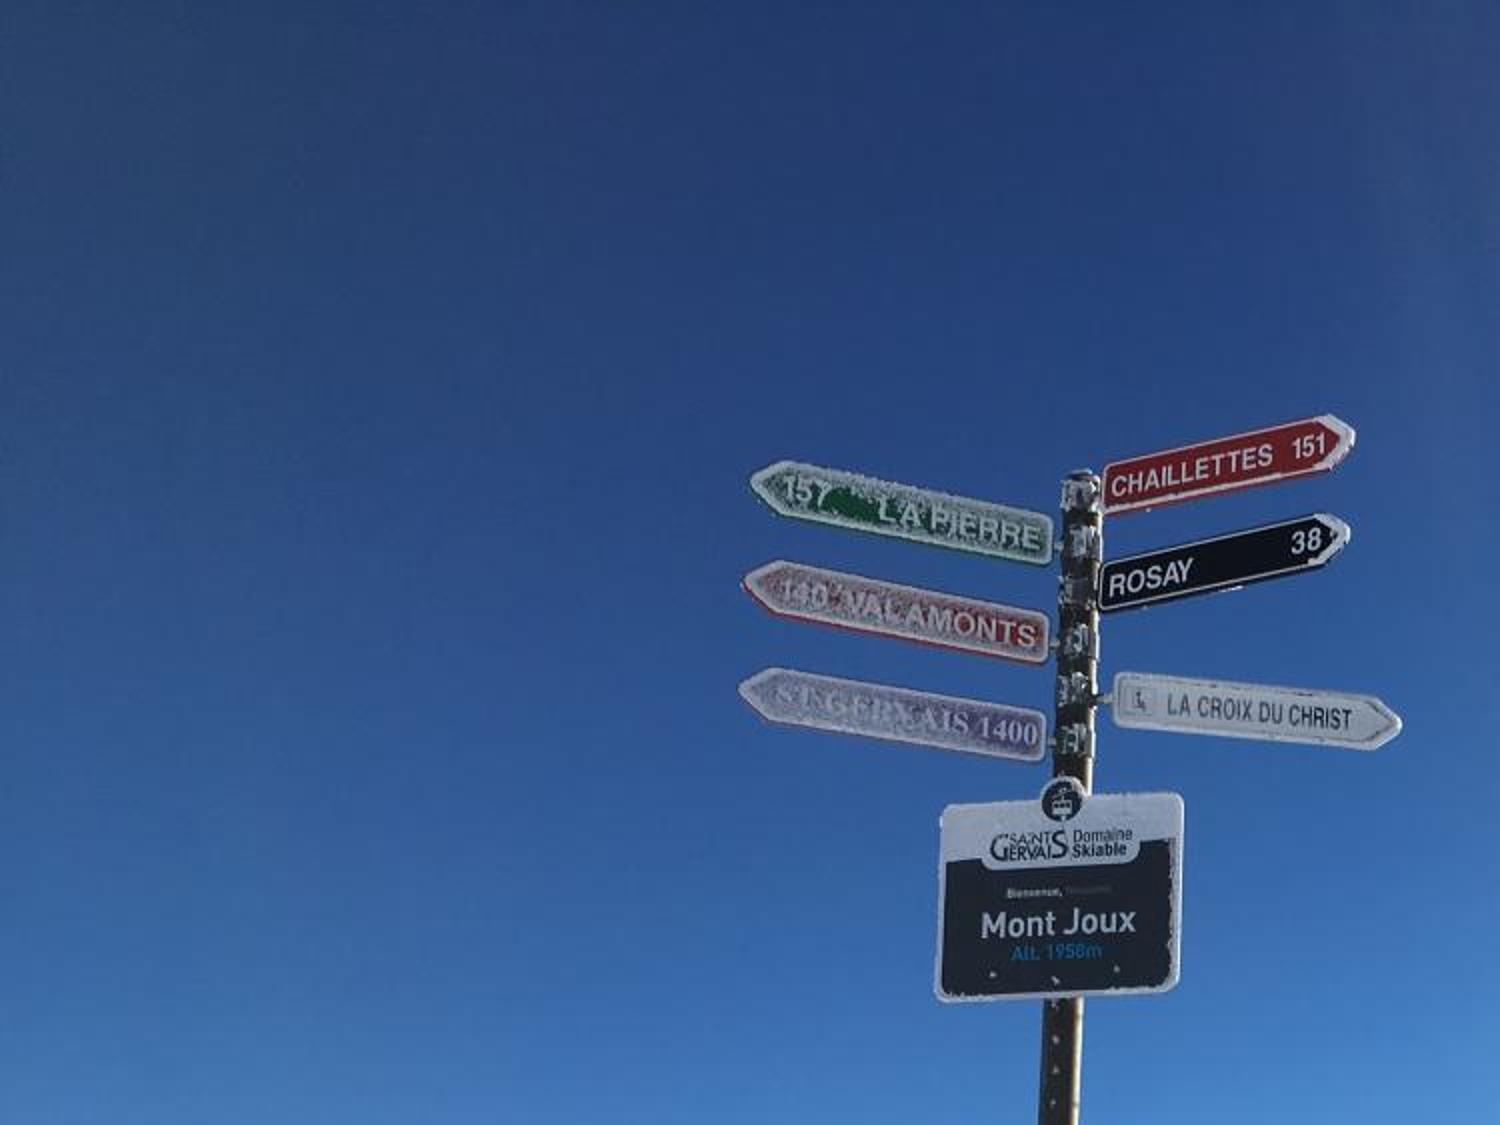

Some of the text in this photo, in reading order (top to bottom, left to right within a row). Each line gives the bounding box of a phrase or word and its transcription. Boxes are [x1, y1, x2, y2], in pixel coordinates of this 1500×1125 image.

[1110, 432, 1326, 497] CHAILLETTES 151
[784, 475, 1041, 550] 157 LA PIERRE
[1109, 527, 1322, 598] ROSAY 38
[848, 590, 1037, 647] VALAMONTS
[979, 716, 1038, 745] 1400
[1167, 693, 1352, 731] LA CROIX DU CHRIST
[1072, 842, 1128, 858] Skiable
[1073, 828, 1133, 843] Domaine
[981, 907, 1137, 939] Mont Joux
